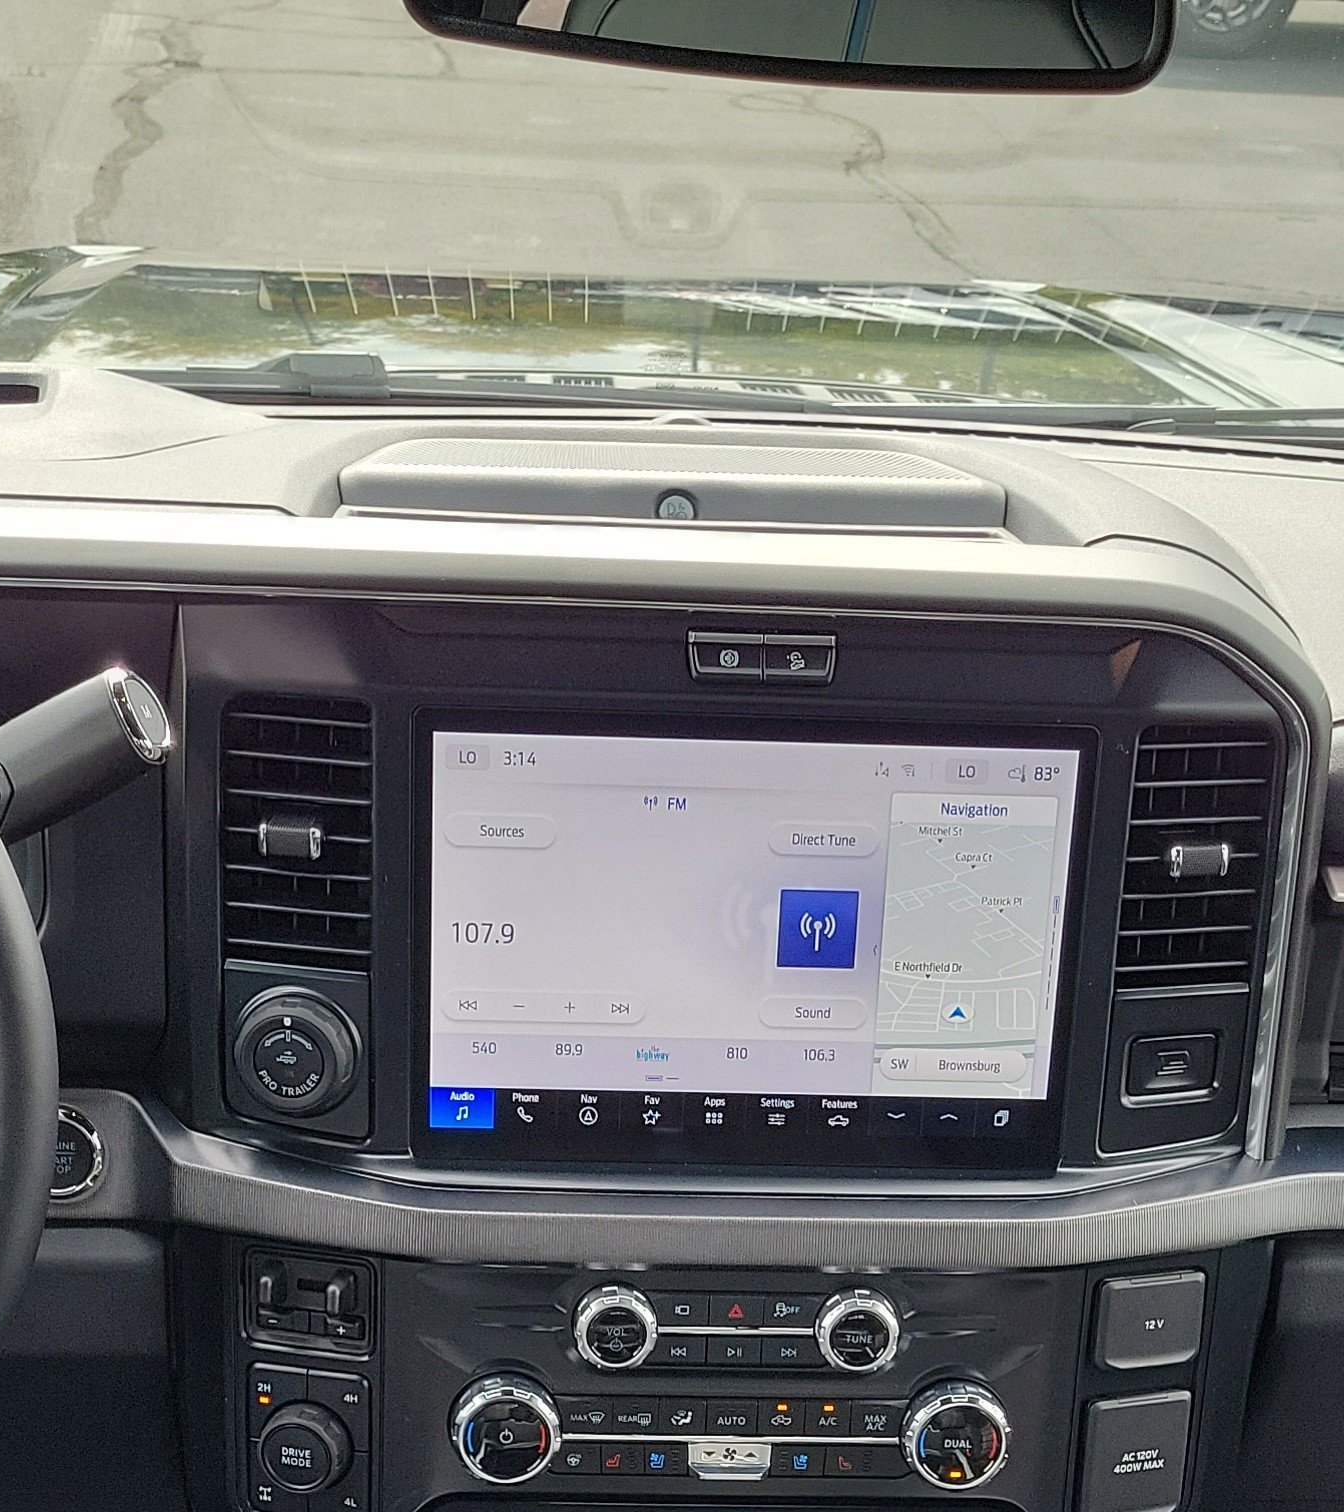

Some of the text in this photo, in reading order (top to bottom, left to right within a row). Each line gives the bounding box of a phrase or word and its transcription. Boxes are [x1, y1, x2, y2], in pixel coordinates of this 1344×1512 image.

[458, 750, 477, 764] LO
[503, 751, 536, 767] 3:14
[958, 765, 976, 779] LO
[1034, 766, 1061, 782] 83°
[667, 797, 687, 811] FM
[940, 802, 1008, 818] Navigation
[479, 824, 525, 838] Sources
[918, 826, 963, 837] Mitchel St
[791, 833, 856, 847] Direct Tune
[955, 852, 993, 864] Capra Ct
[981, 896, 1012, 907] Patrick
[451, 922, 515, 945] 107.9
[894, 962, 963, 974] E Northfield Dr
[794, 1006, 831, 1020] Sound
[472, 1041, 497, 1055] 540
[555, 1043, 583, 1057] 89.9
[726, 1047, 748, 1060] 810
[803, 1048, 835, 1062] 106.3
[890, 1058, 1001, 1074] SW Brownsburg
[258, 1069, 320, 1097] PRO TRAILER
[449, 1091, 475, 1102] Audio
[512, 1092, 540, 1103] Phone
[580, 1094, 598, 1104] Nav
[644, 1095, 661, 1106] Fav
[704, 1096, 726, 1108] Apps
[760, 1097, 795, 1110] Settings
[821, 1098, 858, 1110] Features
[784, 1305, 801, 1315] OFF
[1144, 1319, 1165, 1330] 12 V
[606, 1326, 627, 1337] VOL
[845, 1334, 874, 1345] TUNE
[257, 1382, 271, 1394] 2H
[343, 1393, 358, 1404] 4H
[570, 1414, 589, 1422] MAX
[617, 1414, 638, 1423] REAR
[716, 1415, 746, 1426] AUTO
[818, 1416, 838, 1427] A/C
[864, 1414, 888, 1424] MAX
[865, 1422, 885, 1432] A/C
[943, 1438, 973, 1449] DUAL
[281, 1446, 312, 1459] DRIVE
[1121, 1449, 1159, 1463] AC 120V
[281, 1456, 312, 1468] MODE
[1113, 1458, 1165, 1475] 400W MAX
[343, 1497, 357, 1508] 4L
